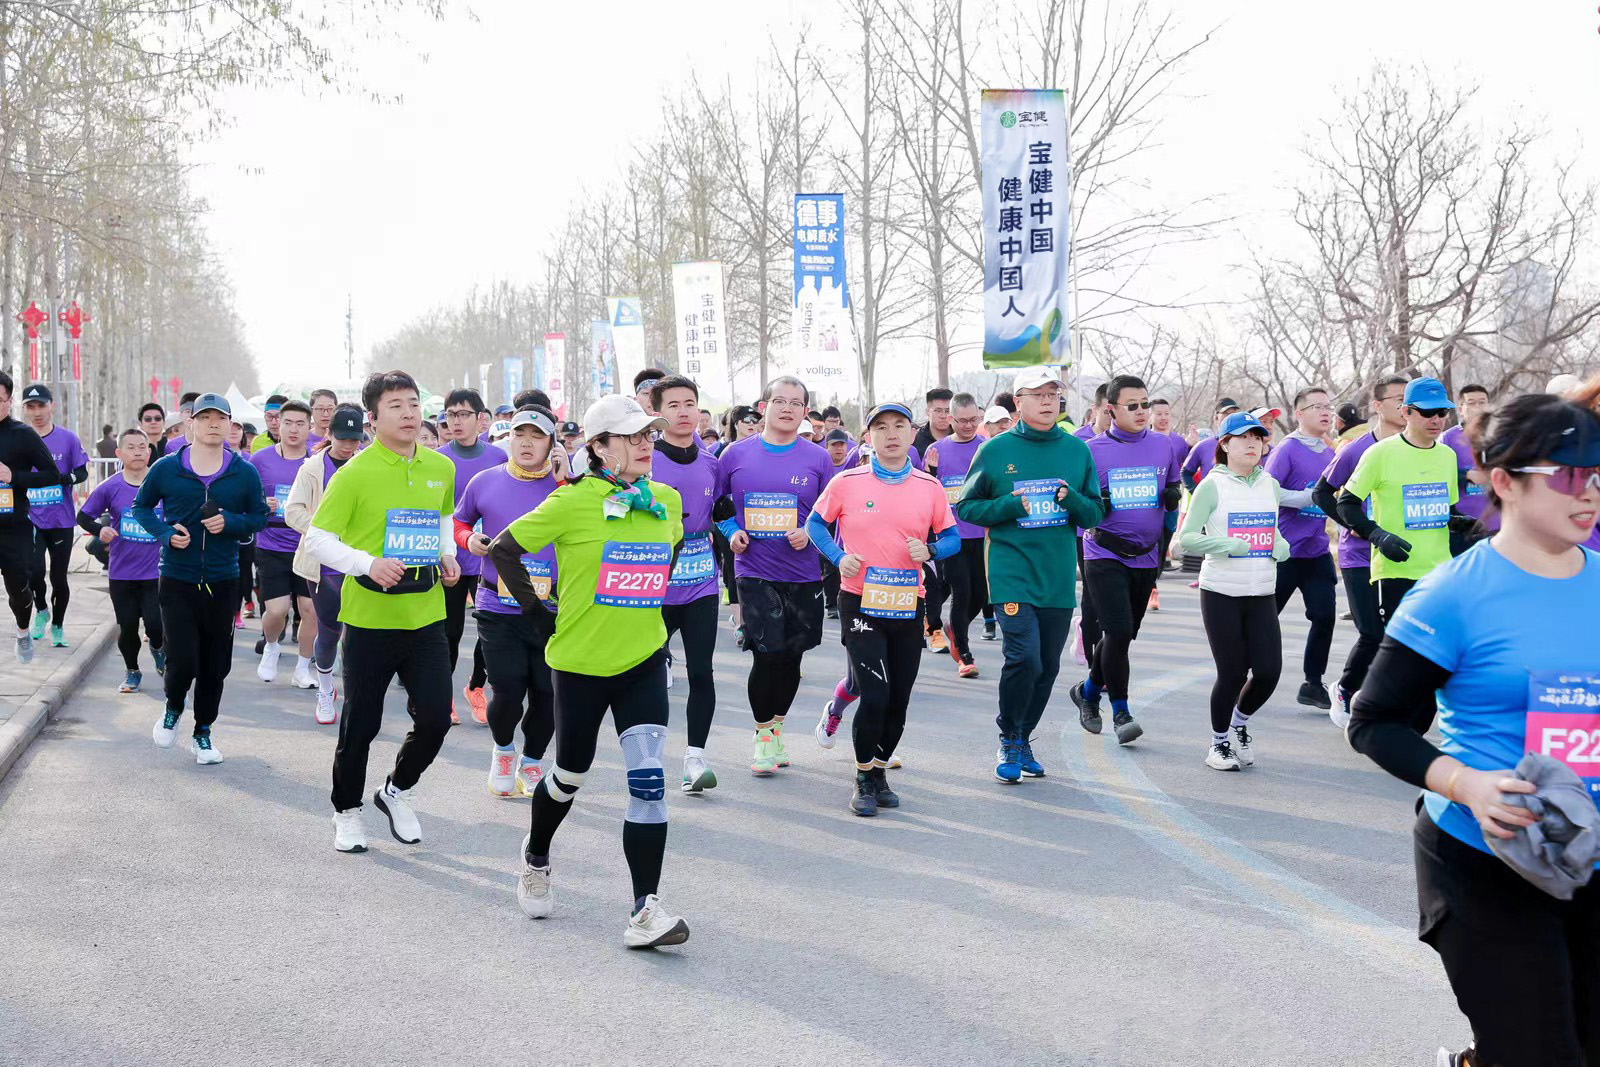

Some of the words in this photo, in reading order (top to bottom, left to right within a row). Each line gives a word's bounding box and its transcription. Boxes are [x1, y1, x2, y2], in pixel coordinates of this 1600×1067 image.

[1018, 110, 1048, 123] 宝健
[1029, 141, 1053, 253] 宝健中国
[998, 177, 1025, 318] 健康中国人
[701, 293, 717, 353] 宝健中国
[806, 365, 842, 377] vollgas
[790, 475, 808, 486] 北京
[26, 488, 61, 499] M1770
[1112, 485, 1156, 499] M1590
[748, 513, 793, 527] T3127
[1407, 503, 1449, 523] M1200
[388, 533, 439, 551] M1252
[606, 571, 664, 590] F2279
[868, 590, 914, 606] T3126
[1541, 728, 1600, 763] F22
